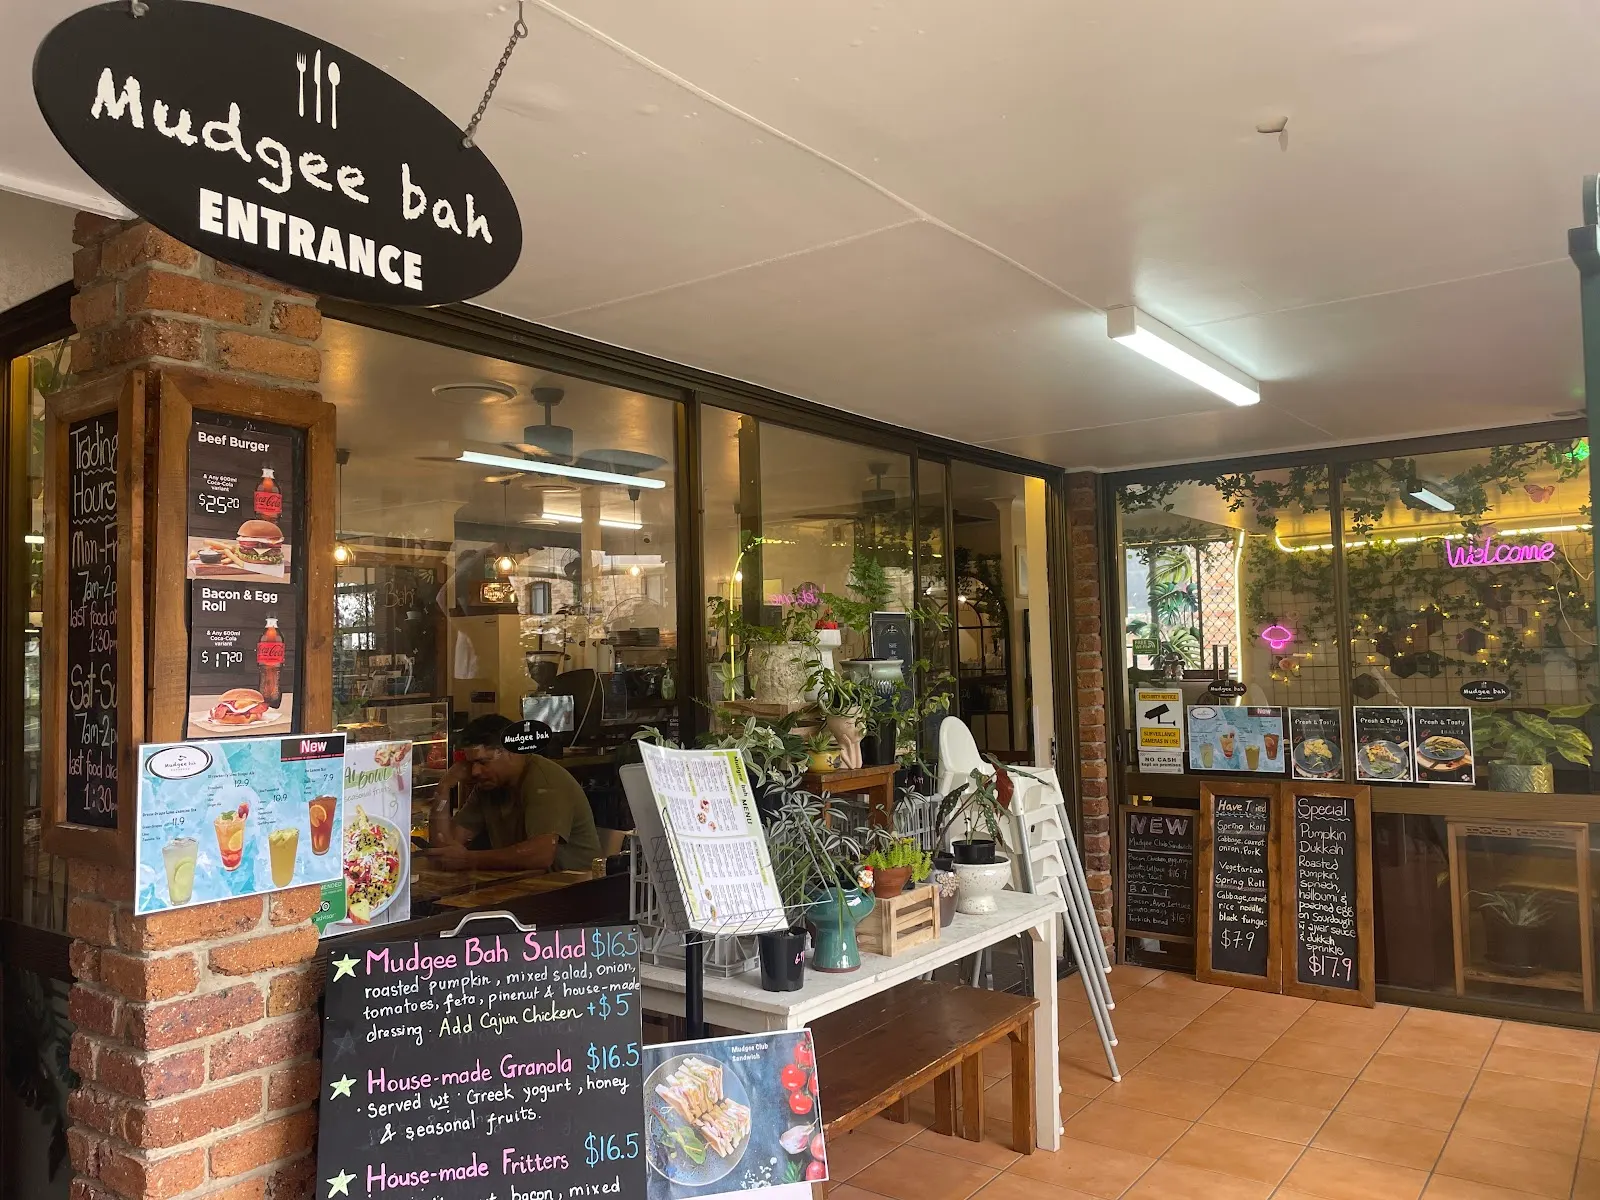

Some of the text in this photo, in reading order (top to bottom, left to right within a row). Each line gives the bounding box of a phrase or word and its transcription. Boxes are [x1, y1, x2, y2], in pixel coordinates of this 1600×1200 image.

[91, 66, 494, 244] Mudgee bah
[199, 188, 423, 291] ENTRANCE
[198, 431, 270, 452] Beef Burger
[206, 480, 234, 488] Coca-Cola
[74, 471, 117, 517] Hours
[1445, 536, 1556, 568] Welcome
[202, 588, 278, 603] Bacon & Egg
[70, 600, 108, 630] last food
[202, 600, 226, 612] Roll
[1463, 687, 1506, 696] Mudgee bah
[1319, 718, 1336, 726] Tasty
[1386, 718, 1404, 726] Tasty
[1446, 719, 1465, 727] Tasty
[504, 730, 550, 744] Mudgee bah
[301, 740, 327, 754] New
[69, 749, 103, 782] last food
[234, 779, 250, 788] 12.9
[734, 756, 744, 781] Mudgee
[742, 799, 753, 825] MENU
[1218, 799, 1243, 811] Have
[1297, 798, 1347, 821] Special
[1130, 814, 1189, 836] NEW
[1217, 820, 1266, 834] Spring Roll
[1299, 822, 1347, 843] Pumpkin
[1129, 837, 1153, 850] Mudgee
[1153, 839, 1168, 848] Club
[1299, 840, 1344, 856] Dukkah
[1218, 860, 1263, 874] Vegetarian
[1298, 854, 1339, 871] Roasted
[1168, 868, 1188, 880] $16.9
[1215, 873, 1265, 891] Spring Roll
[1299, 888, 1347, 906] halloumi &
[1218, 902, 1235, 911] rice
[1298, 911, 1310, 920] on
[1299, 901, 1354, 918] poached egg
[1219, 911, 1268, 929] black fungus
[1220, 927, 1255, 952] $7.9
[1330, 926, 1356, 938] sauce
[366, 928, 639, 980] Mudgee Bah Salad $16.5
[1305, 943, 1345, 956] sprinkle
[1308, 954, 1352, 982] $17.9
[364, 975, 419, 999] roasted
[506, 965, 548, 985] mixed
[553, 961, 593, 982] salad,
[596, 961, 636, 976] onion,
[363, 976, 640, 1020] tomatoes, feta, pinenut & house-made
[438, 999, 584, 1038] Add Cajun Chicken
[731, 1044, 755, 1053] Mudgee
[732, 1053, 761, 1062] Sandwich
[367, 1042, 640, 1095] House-made Granola $16.5
[466, 1083, 515, 1104] Greek
[586, 1074, 630, 1095] honey
[379, 1106, 542, 1145] & seasonal fruits.
[367, 1131, 639, 1193] House-made Fritters $16.5
[569, 1175, 621, 1197] mixed
